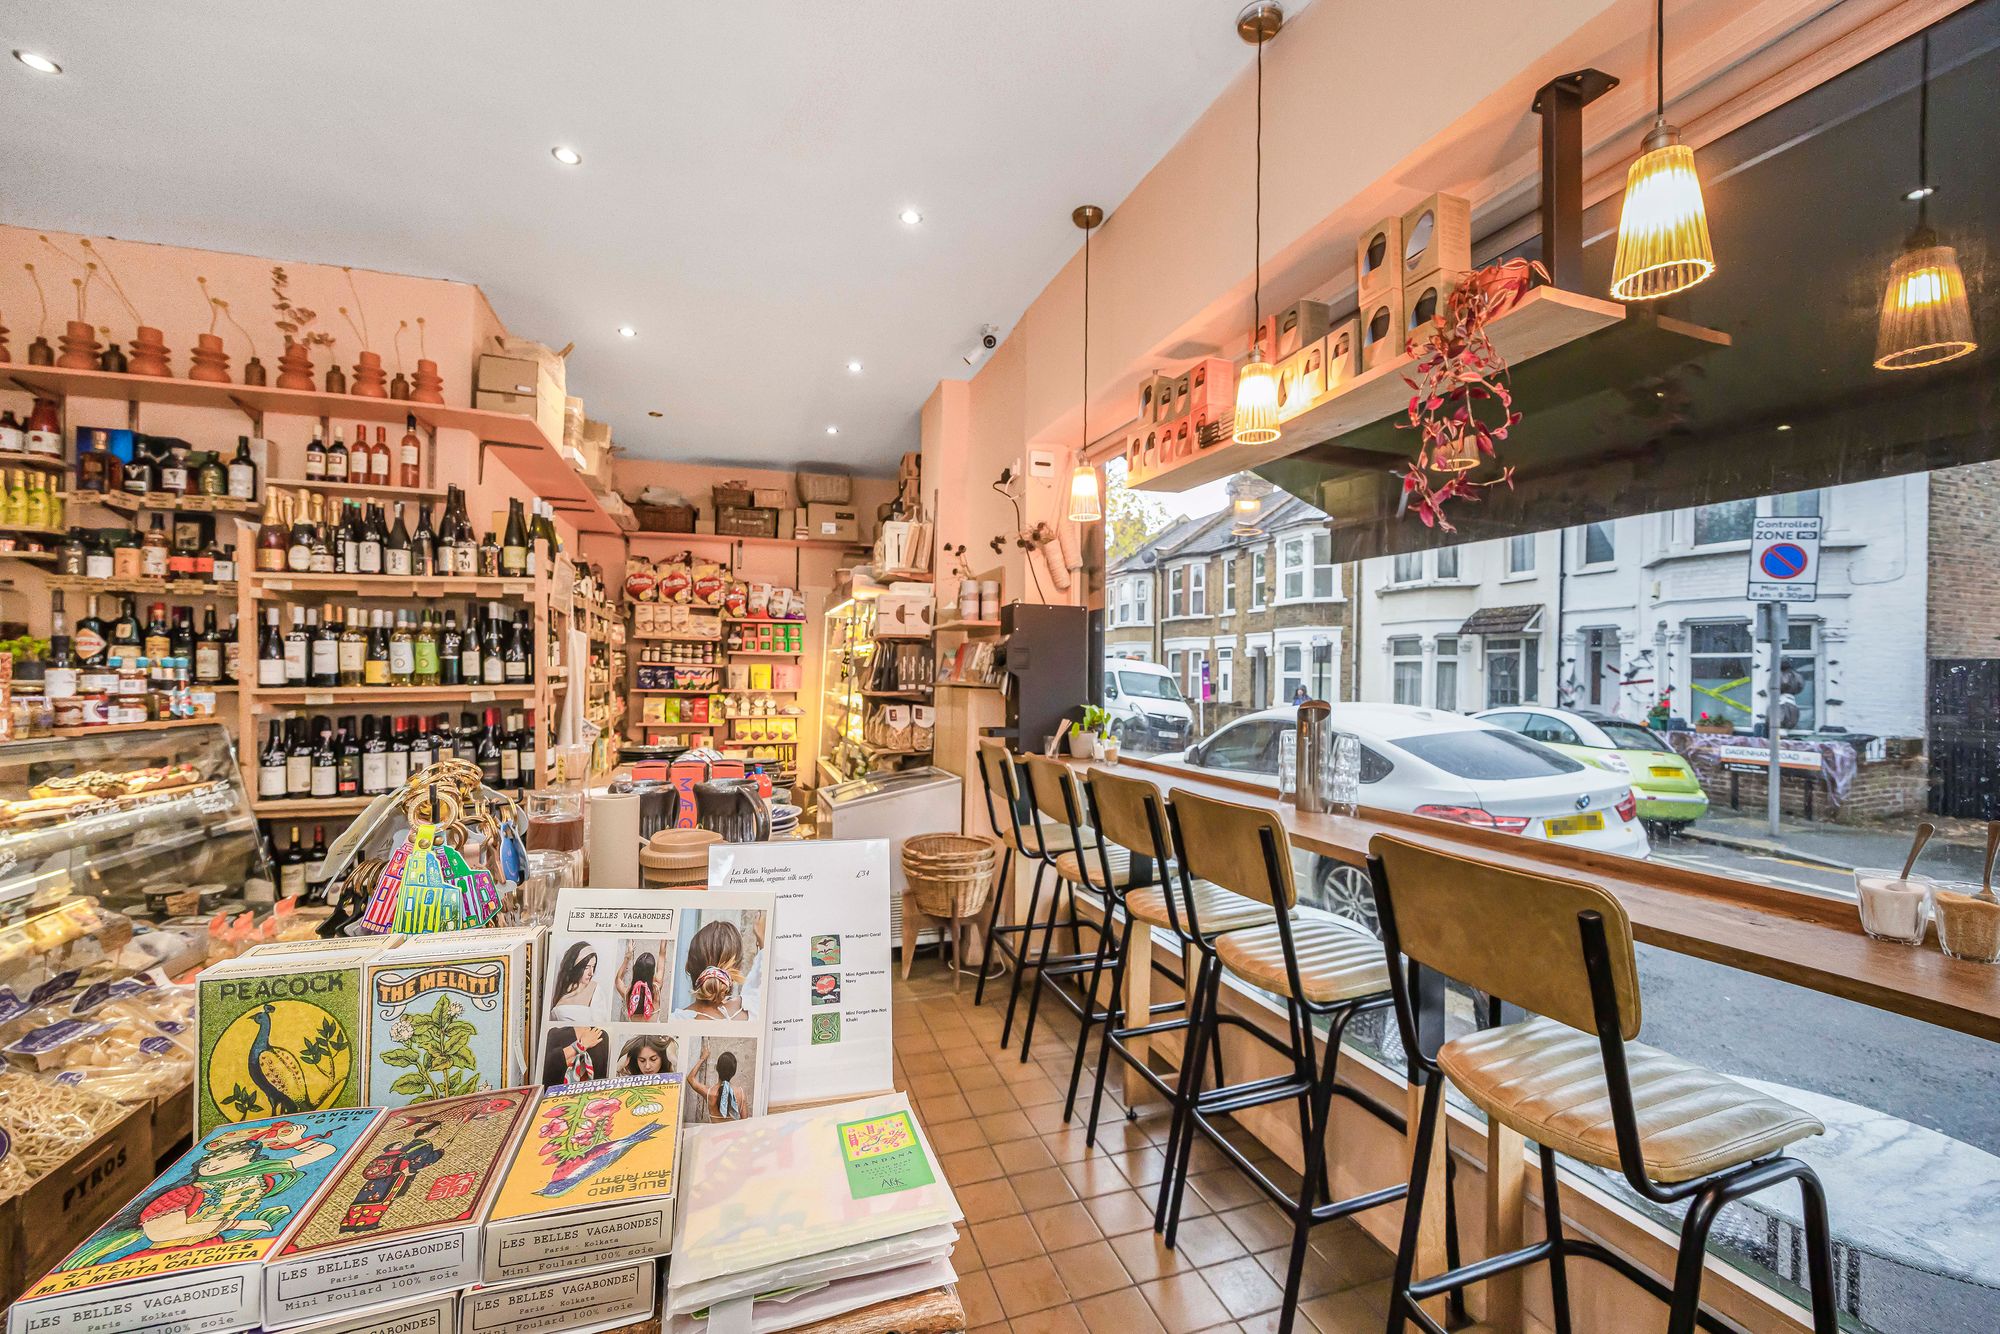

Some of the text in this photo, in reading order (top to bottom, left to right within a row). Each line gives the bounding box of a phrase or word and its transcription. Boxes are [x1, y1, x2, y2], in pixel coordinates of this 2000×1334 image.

[1755, 531, 1793, 540] ZONE
[1756, 520, 1818, 529] Controlled
[571, 911, 671, 921] LES BELLES VAGABONDES
[220, 972, 344, 1001] PEACOCK
[379, 970, 496, 1001] THE MELATTI
[306, 1109, 374, 1121] DANCING
[315, 1114, 362, 1124] GIRL
[854, 1150, 913, 1169] BANDANA
[587, 1179, 667, 1197] BLUE BIRD
[503, 1216, 659, 1249] LES BELLES VAGABONDES
[544, 1244, 570, 1254] Paris
[584, 1237, 619, 1248] Kolkata
[64, 1242, 254, 1281] SAFETY MATCHES
[281, 1239, 460, 1282] LES BELLES VAGABONDES
[502, 1246, 654, 1277] Mini Foulard 100% soie
[34, 1250, 258, 1296] M. N. MEHTA CALCUTTA
[330, 1273, 359, 1284] Paris
[375, 1263, 416, 1276] Kolkata
[285, 1270, 459, 1311] Mini Foulard 100% soie
[476, 1272, 636, 1312] LES BELLES VAGABONDES
[29, 1283, 239, 1331] LES BELLES VAGABONDES
[515, 1316, 565, 1332] Foulard
[573, 1309, 600, 1320] 100%
[606, 1302, 633, 1313] soie
[519, 1306, 545, 1315] Paris
[560, 1296, 595, 1307] Kolkata
[87, 1321, 121, 1332] Paris
[141, 1309, 187, 1323] Kolkata
[200, 1317, 235, 1328] soie
